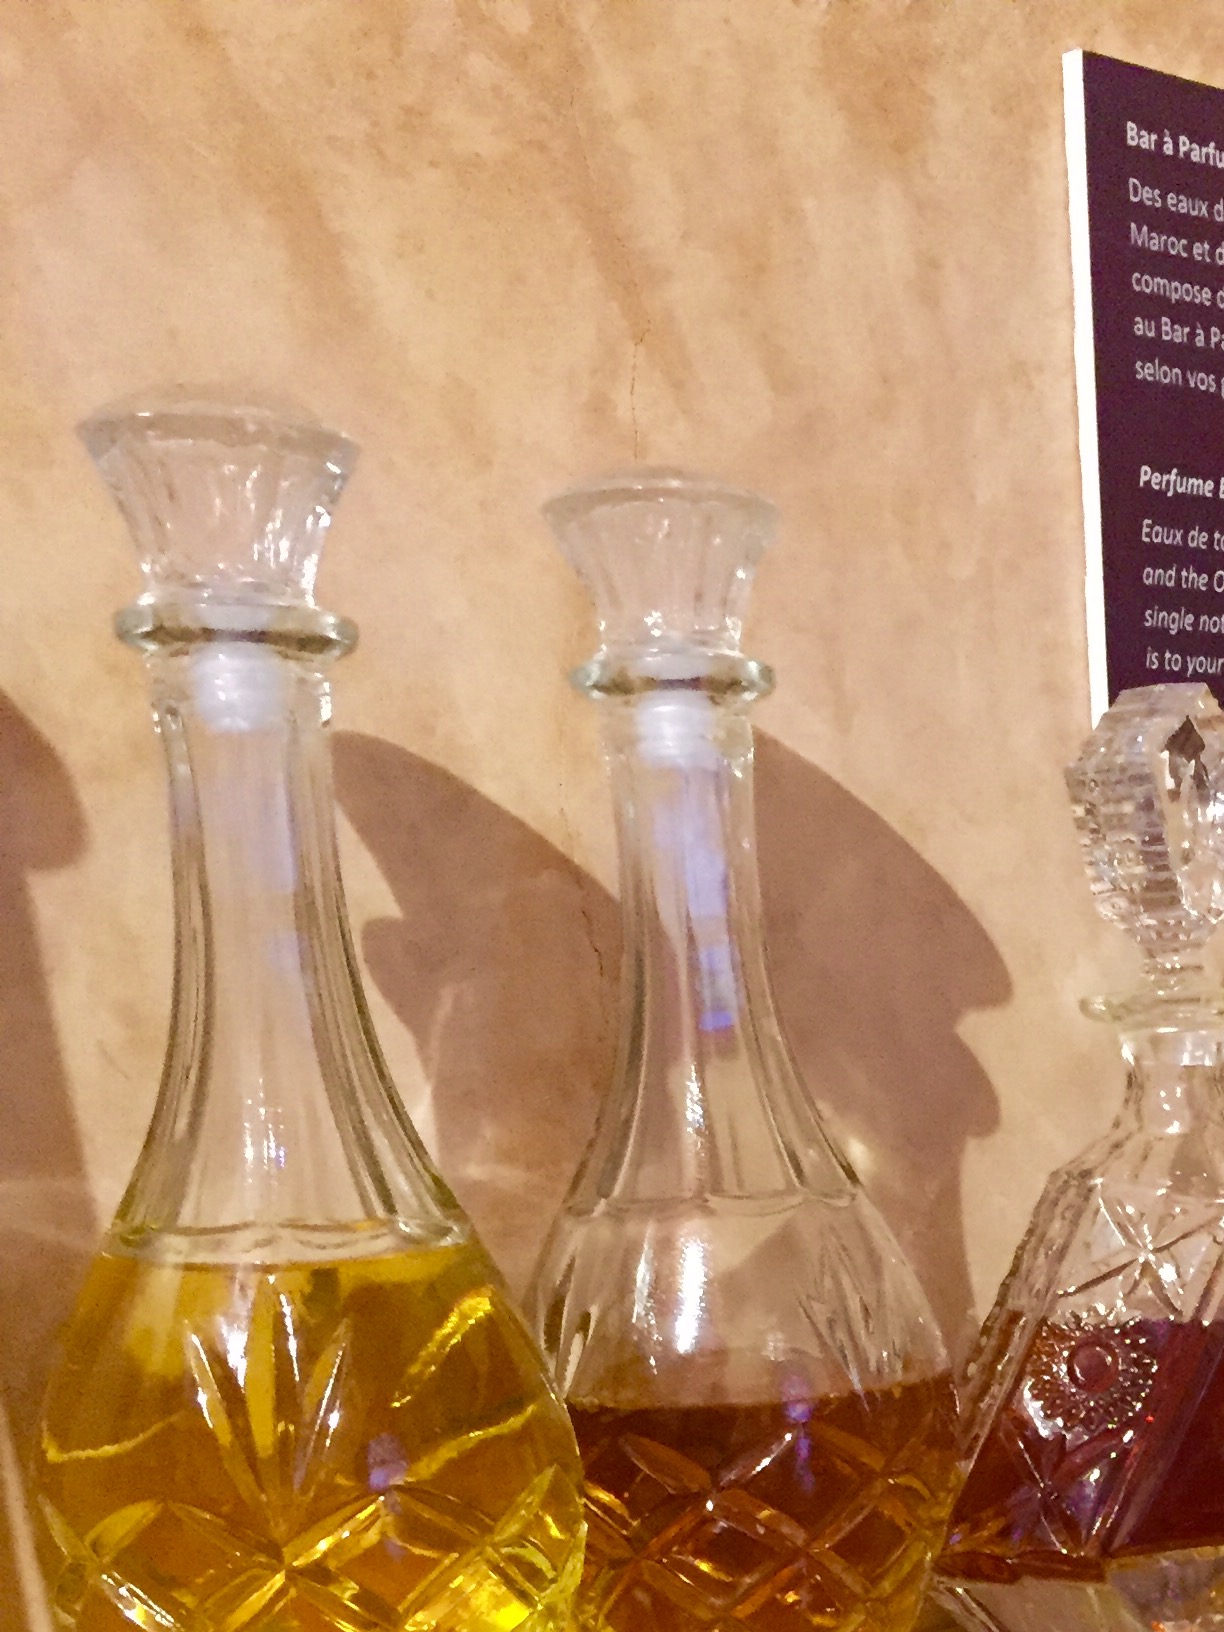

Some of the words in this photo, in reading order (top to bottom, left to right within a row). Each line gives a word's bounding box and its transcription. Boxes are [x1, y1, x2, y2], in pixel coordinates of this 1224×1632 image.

[1125, 121, 1158, 151] Bar
[1162, 129, 1174, 155] à
[1127, 177, 1163, 208] Des
[1166, 192, 1209, 218] eaux
[1129, 222, 1189, 257] Maroc
[1192, 240, 1212, 263] et
[1131, 272, 1212, 306] compose
[1132, 317, 1156, 337] au
[1160, 316, 1190, 343] Bar
[1195, 322, 1206, 347] à
[1134, 357, 1183, 386] selon
[1188, 370, 1217, 393] vos
[1138, 465, 1214, 497] Perfume
[1141, 519, 1184, 546] Eaux
[1187, 526, 1209, 549] de
[1142, 564, 1177, 587] and
[1180, 565, 1209, 591] the
[1143, 605, 1195, 635] single
[1145, 646, 1159, 669] is
[1163, 649, 1183, 671] to
